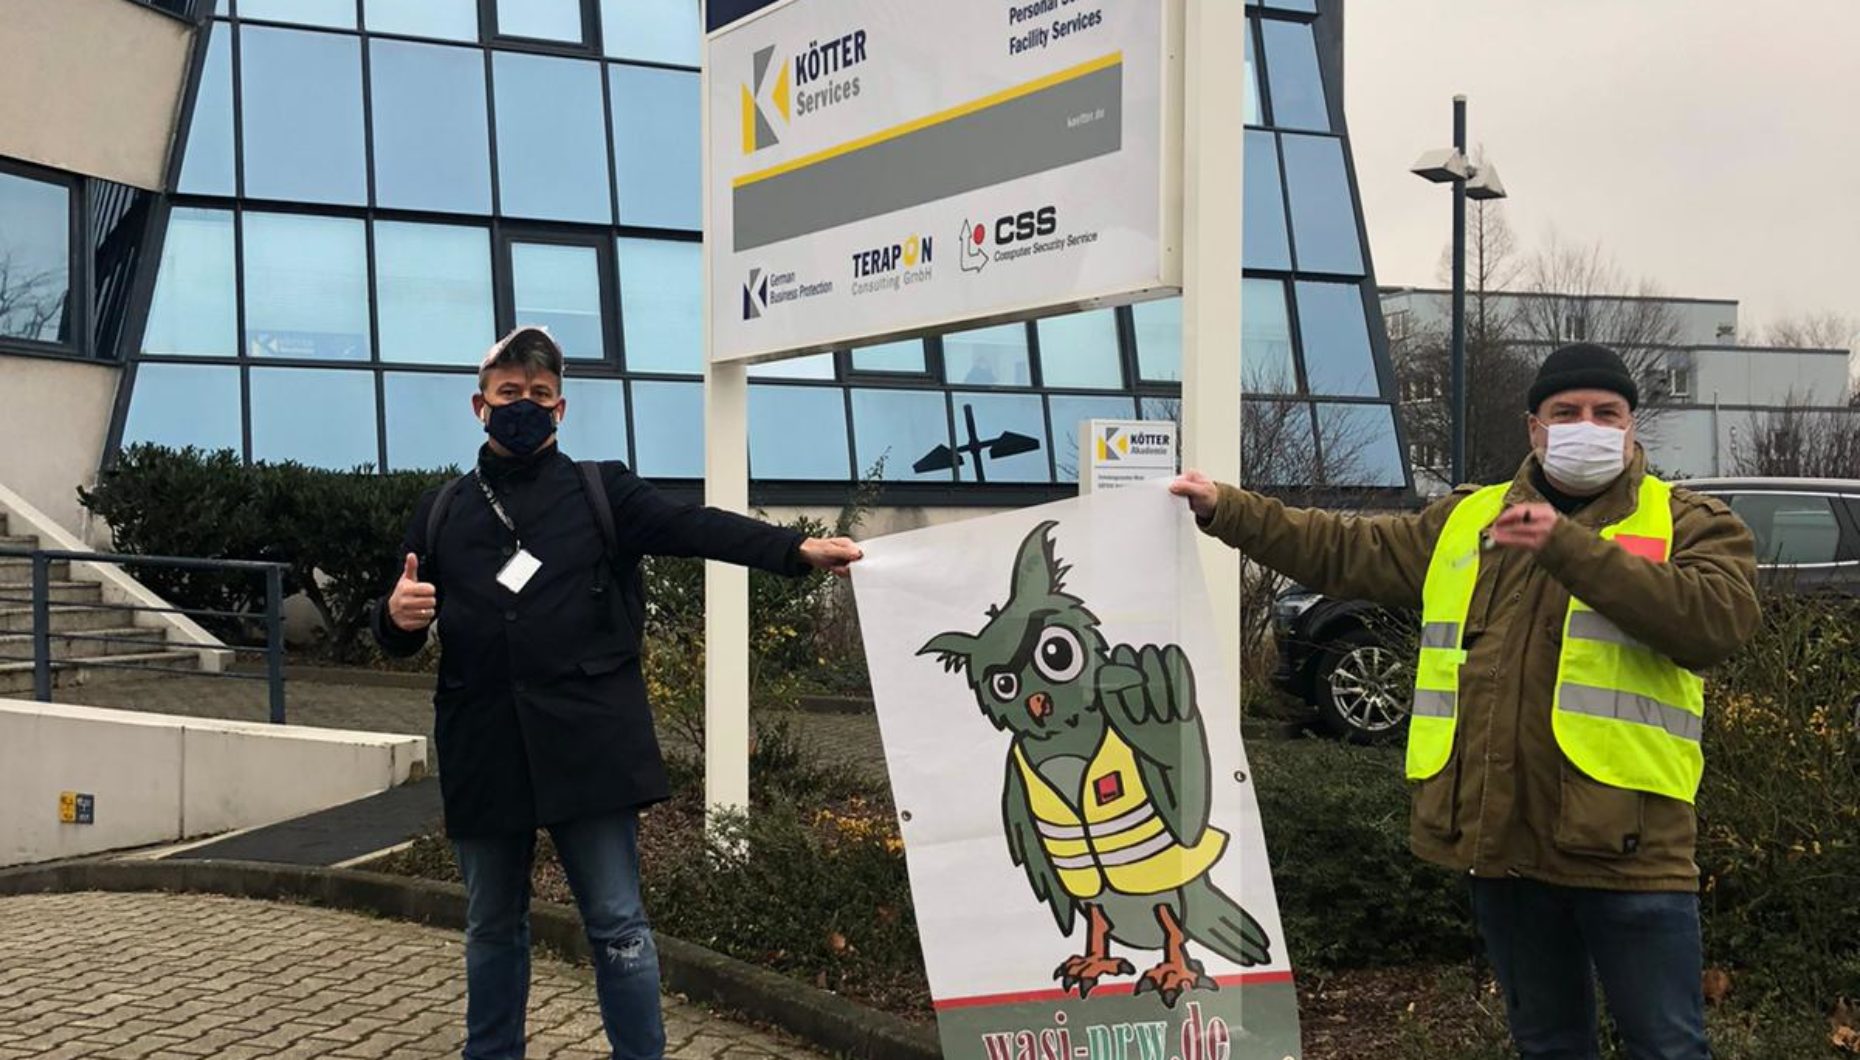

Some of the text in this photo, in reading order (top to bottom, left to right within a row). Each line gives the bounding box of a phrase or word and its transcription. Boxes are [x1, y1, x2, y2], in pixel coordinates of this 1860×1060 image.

[1009, 9, 1103, 55] Facility Services
[795, 29, 867, 87] KÖTTER
[796, 76, 861, 117] Services
[995, 205, 1057, 245] CSS
[852, 234, 933, 279] TERAPON
[994, 232, 1098, 263] Computer Security Service
[770, 272, 795, 287] German
[770, 281, 833, 304] Business Protection
[851, 267, 932, 296] Consulting GmbH
[1130, 431, 1170, 446] KÖTTER
